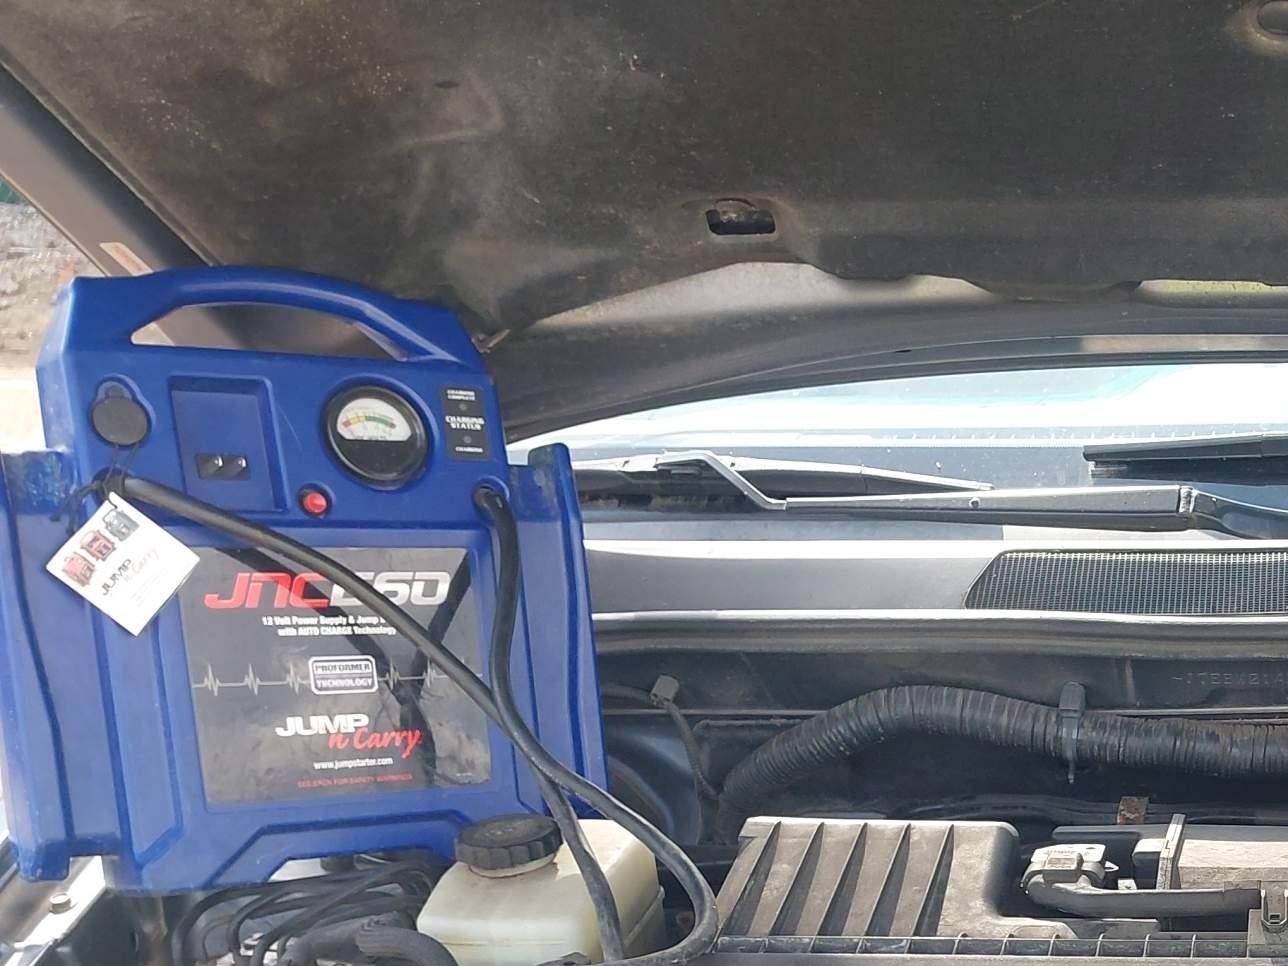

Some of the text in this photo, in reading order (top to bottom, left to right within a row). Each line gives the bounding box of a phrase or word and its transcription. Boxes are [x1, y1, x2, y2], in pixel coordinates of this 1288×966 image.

[262, 615, 274, 626] 12
[274, 615, 292, 625] Volt
[292, 615, 318, 626] Power
[319, 615, 347, 626] Supply
[357, 615, 379, 625] Jump
[277, 626, 397, 636] with AUTO CHARGE Technology
[275, 714, 370, 736] JUMP
[327, 727, 422, 759] n Carry
[313, 757, 394, 770] www.jumpstarter.com
